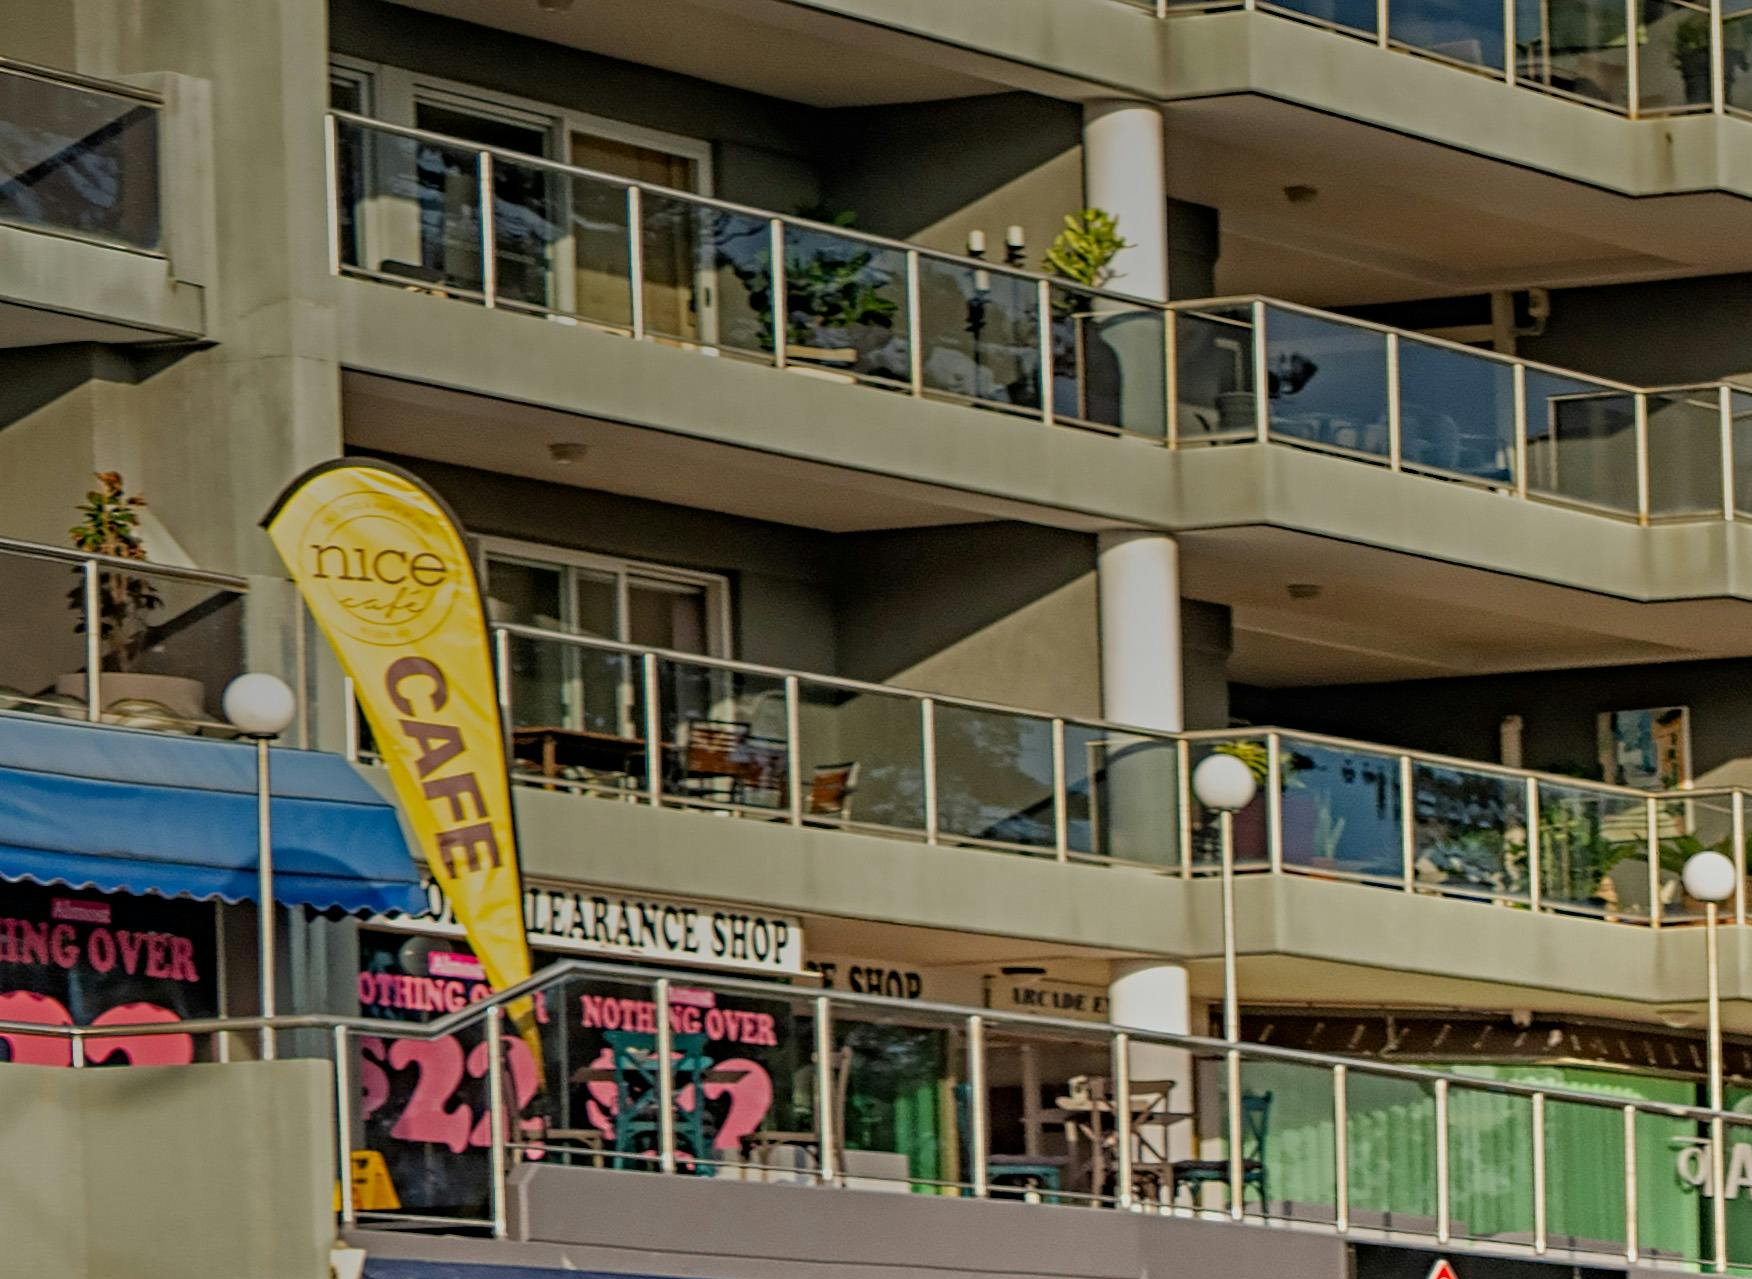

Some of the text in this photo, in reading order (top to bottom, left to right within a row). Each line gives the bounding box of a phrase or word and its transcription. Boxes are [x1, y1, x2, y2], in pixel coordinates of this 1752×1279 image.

[311, 544, 448, 587] nice
[385, 656, 502, 878] CAFE
[528, 888, 698, 953] LEARANCE
[711, 912, 790, 964] SHOP
[88, 927, 200, 982] OVER
[358, 971, 468, 1014] OTHING
[704, 1009, 777, 1046] OVER
